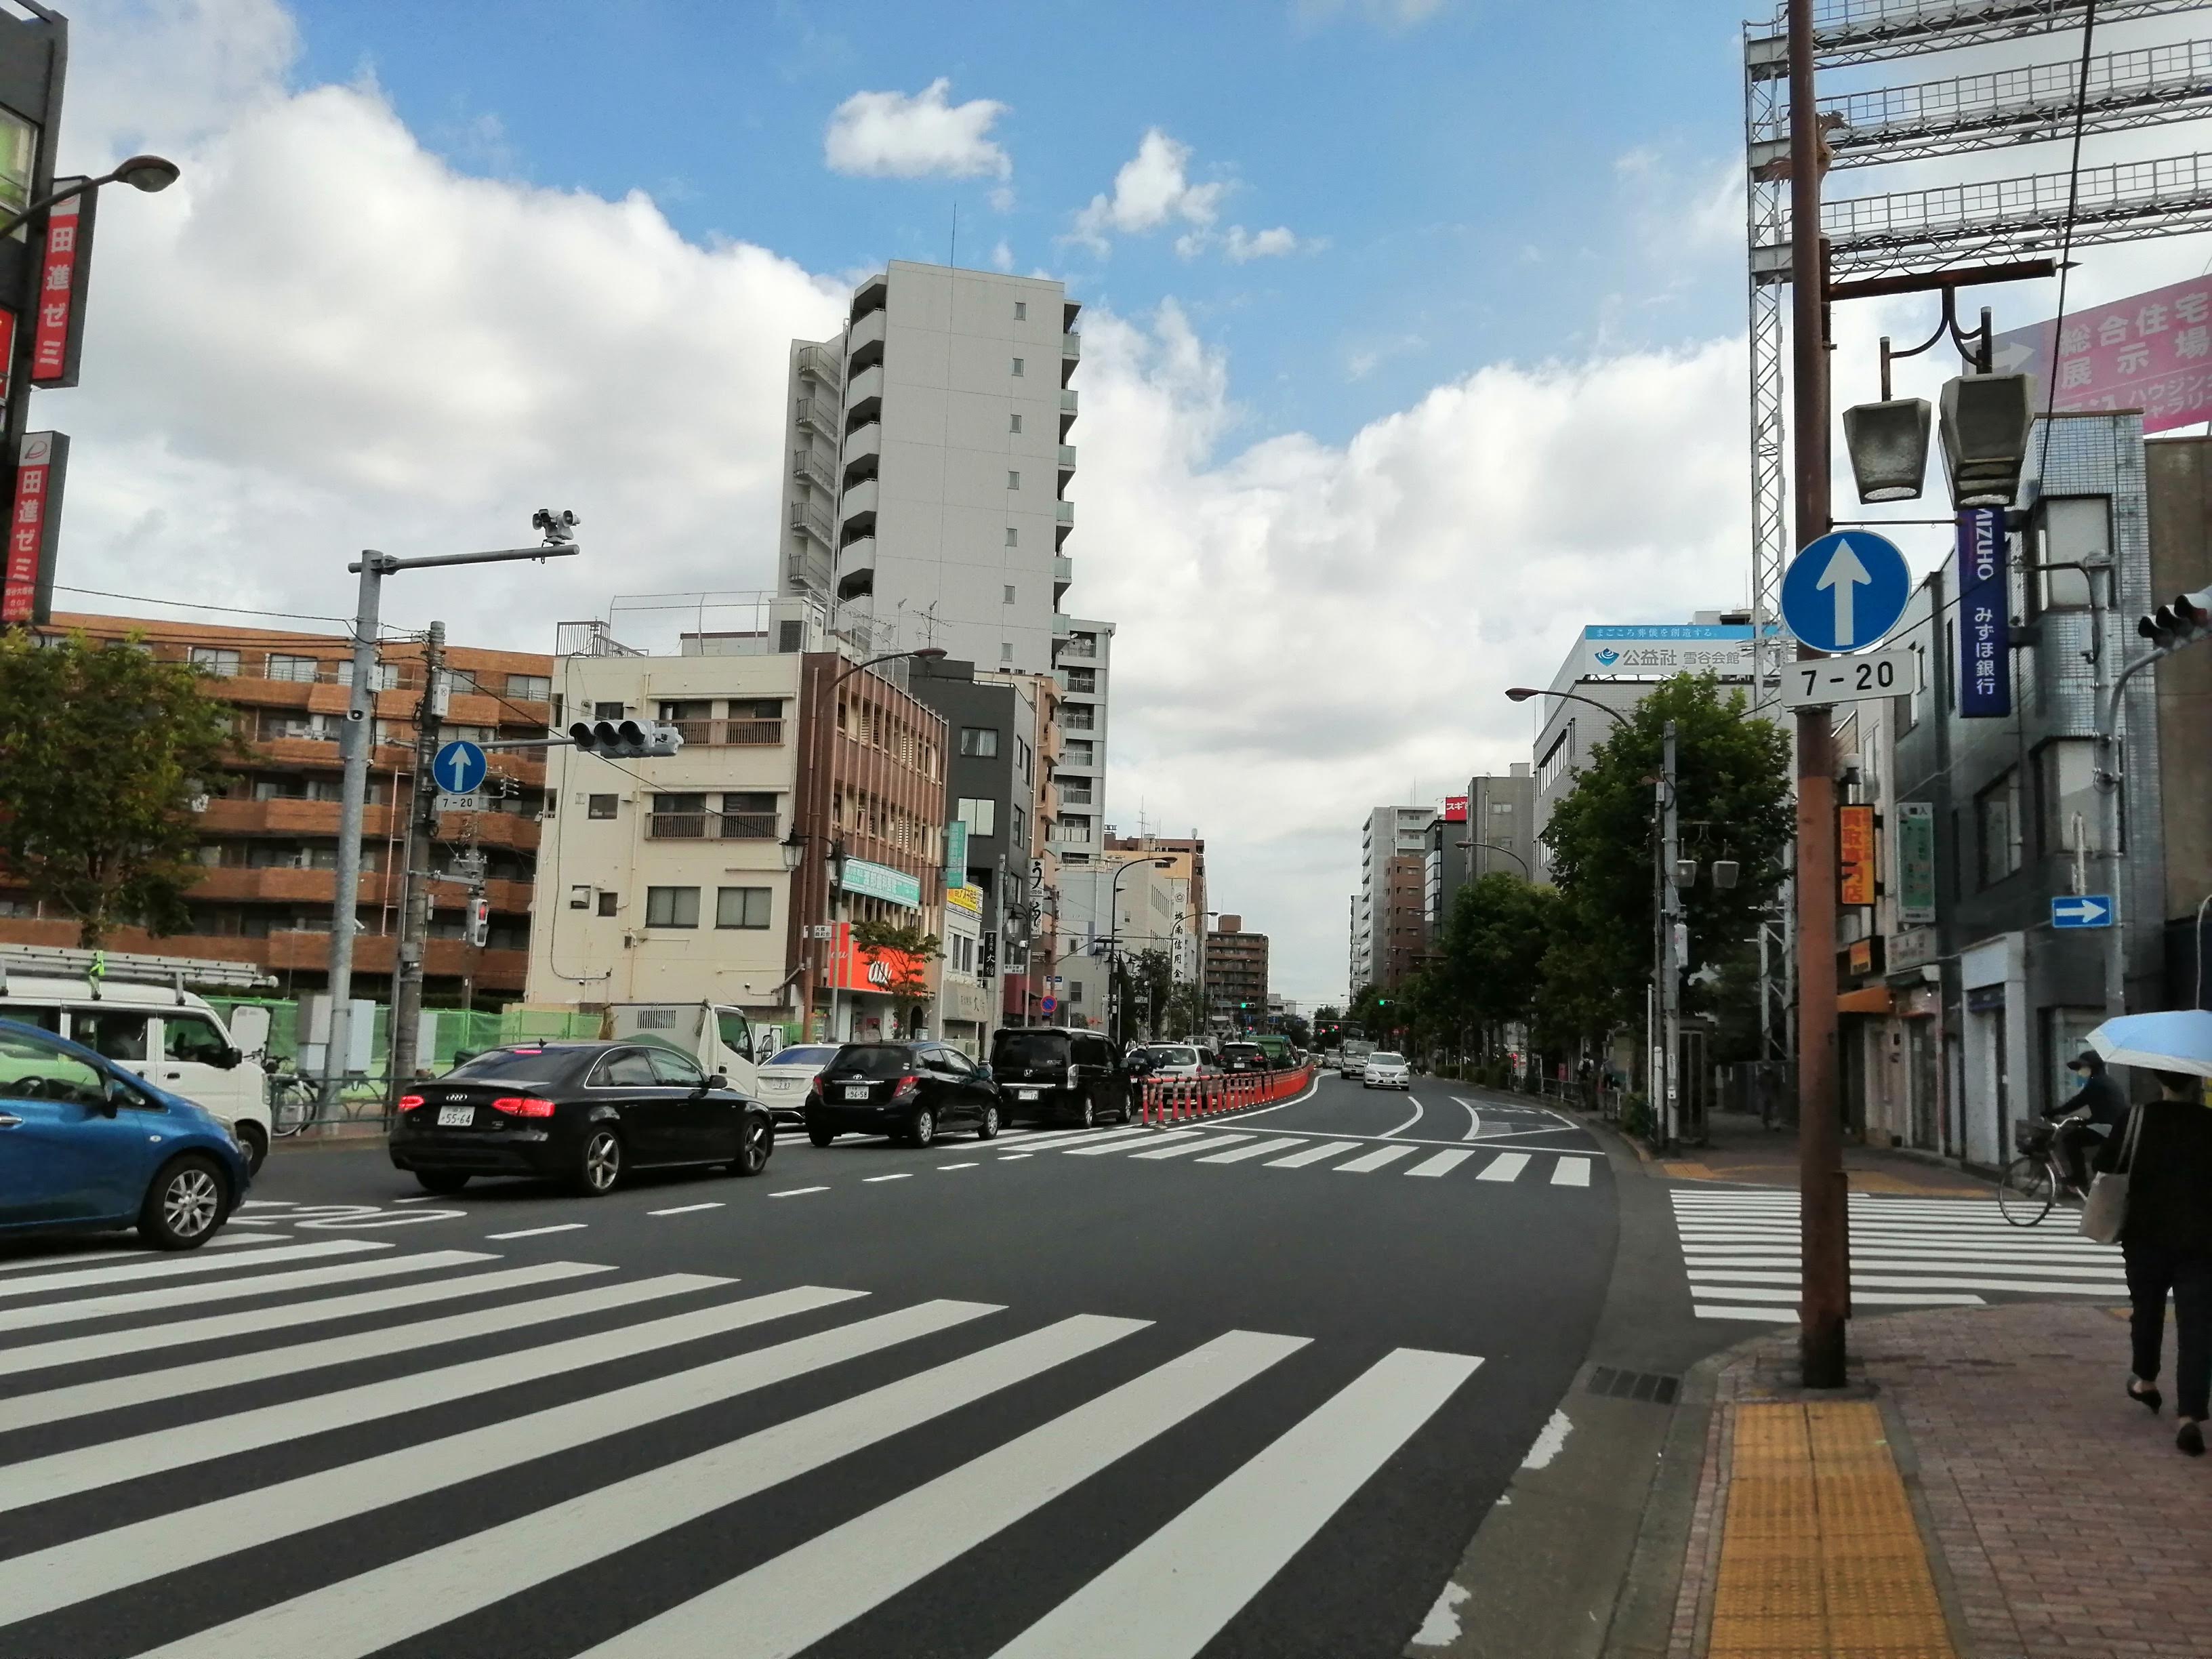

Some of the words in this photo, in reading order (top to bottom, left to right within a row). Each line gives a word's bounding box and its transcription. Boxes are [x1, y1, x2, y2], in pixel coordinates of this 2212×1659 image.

[39, 226, 74, 365] 田進ゼミ
[2058, 291, 2210, 357] 総合住宅
[2061, 325, 2211, 390] 展示場
[2129, 375, 2212, 406] ハウジン
[12, 470, 42, 581] 田進ゼミ
[1622, 649, 1677, 667] 公益社
[1683, 651, 1740, 665] 雪谷会館
[1974, 607, 1995, 695] みずほ銀行
[868, 960, 893, 985] au
